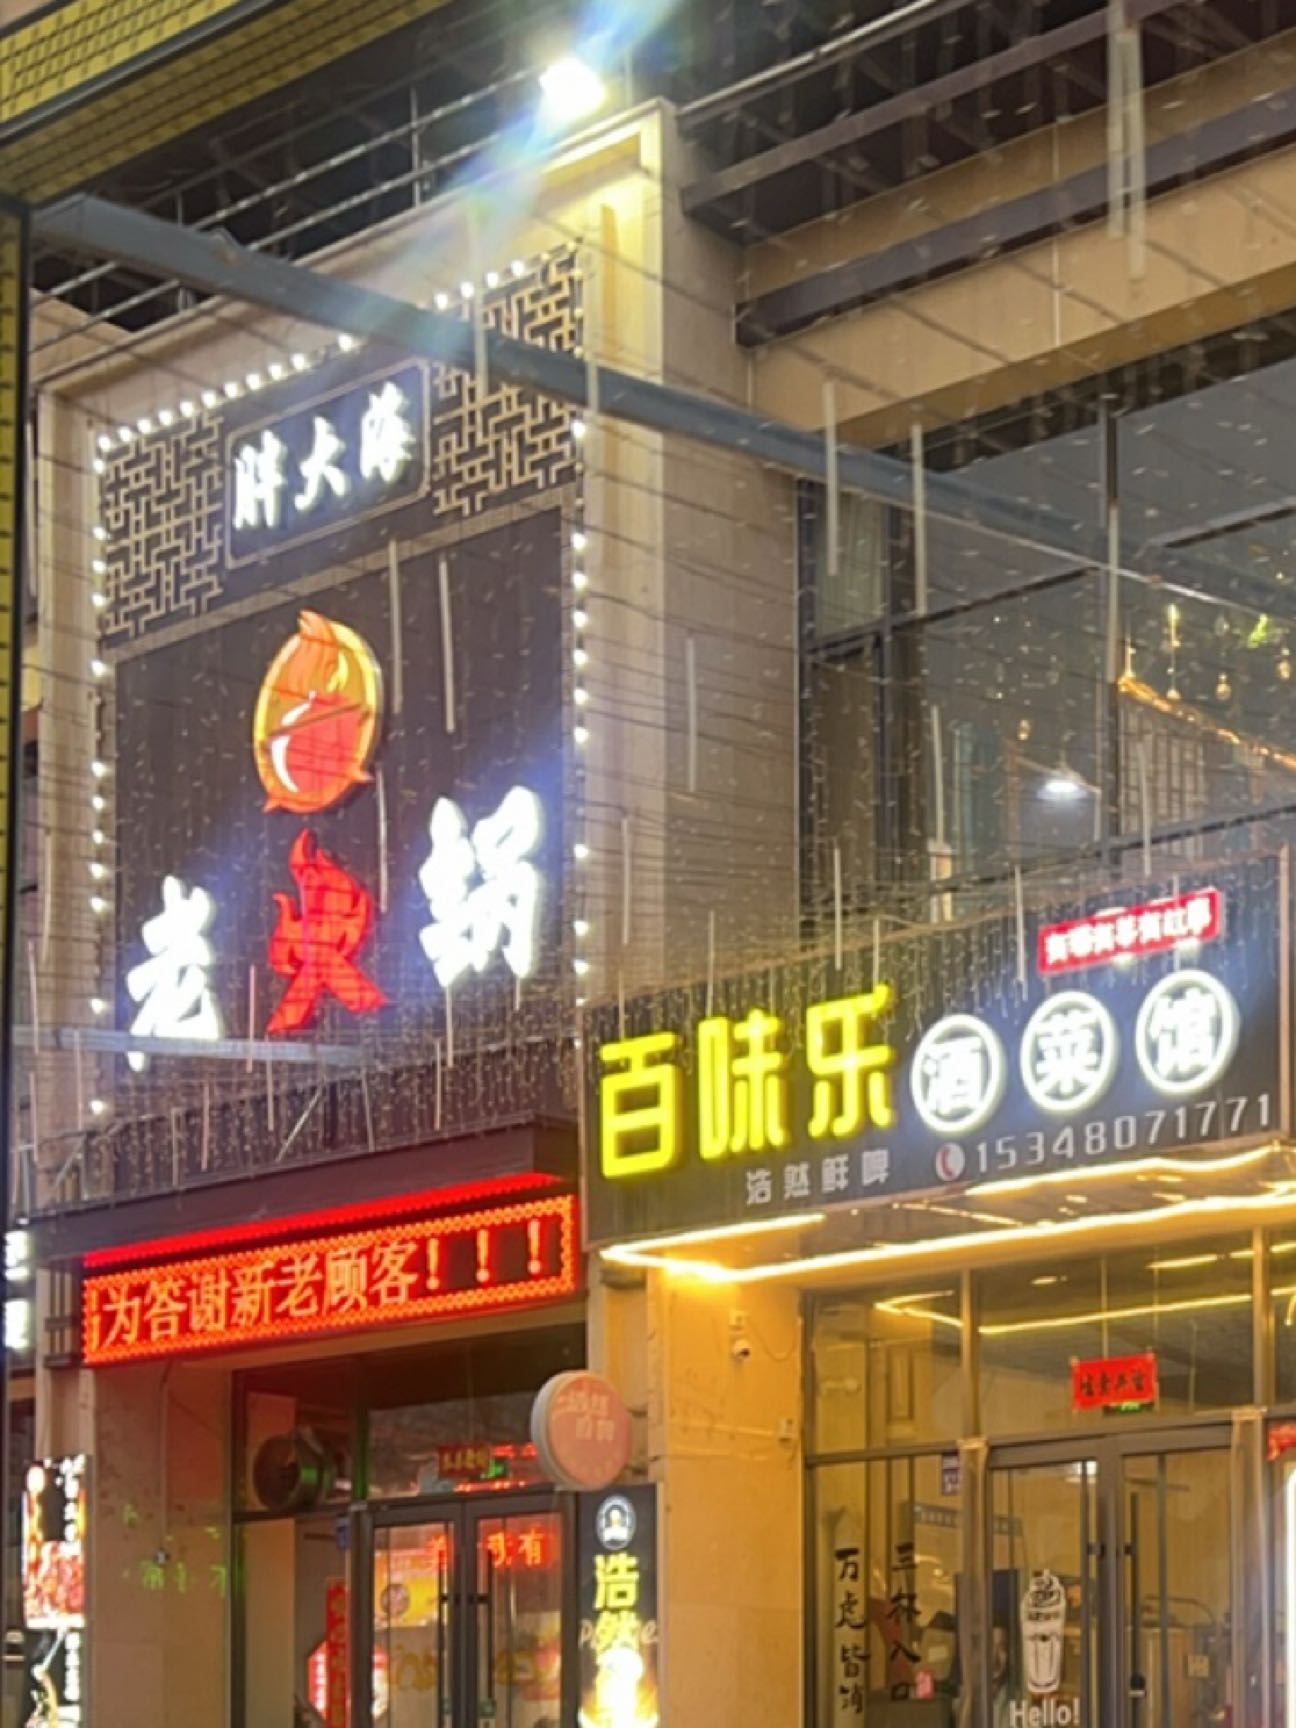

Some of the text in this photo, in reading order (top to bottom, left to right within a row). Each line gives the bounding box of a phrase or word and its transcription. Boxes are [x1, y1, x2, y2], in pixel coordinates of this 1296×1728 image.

[127, 786, 541, 1072] 老火锅
[600, 984, 895, 1180] 百味乐
[977, 1093, 1270, 1173] 15348071771
[90, 1220, 541, 1350] 为答谢新老顾客！！！
[1009, 1697, 1080, 1728] Hello!
